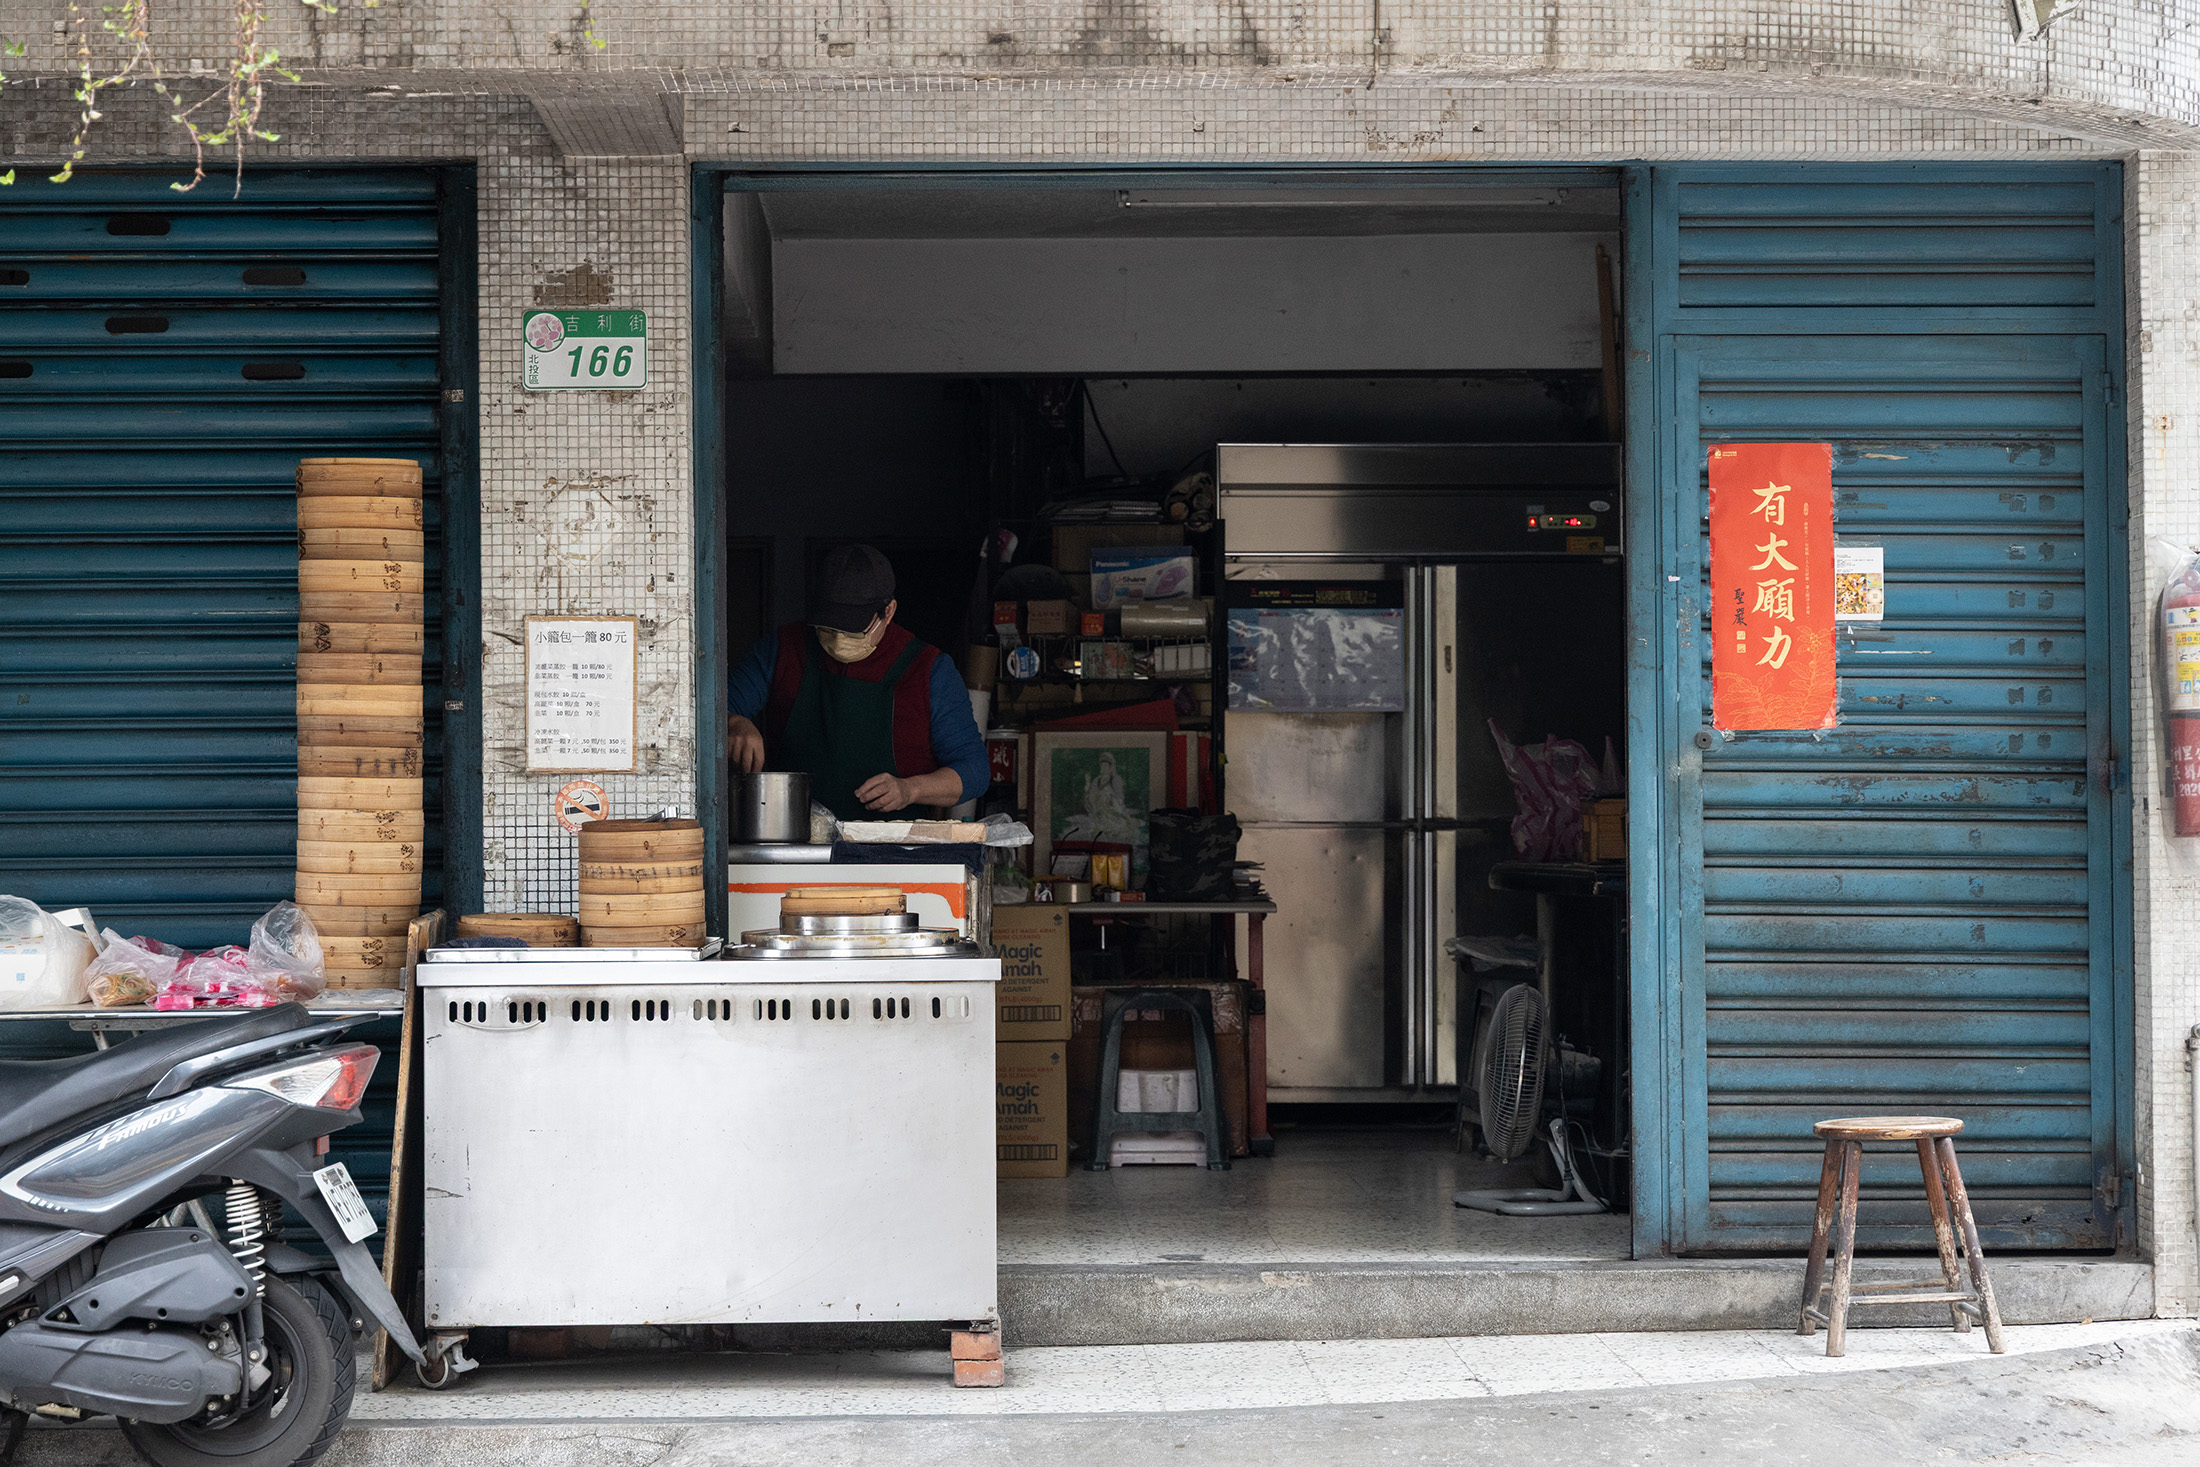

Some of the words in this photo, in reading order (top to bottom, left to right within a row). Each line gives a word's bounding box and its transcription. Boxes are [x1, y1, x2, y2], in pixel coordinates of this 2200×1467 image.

[565, 314, 644, 332] 吉利街
[528, 354, 540, 385] 北投區
[568, 345, 634, 378] 166
[1095, 560, 1130, 568] Panasonic
[1748, 480, 1800, 670] 有大願力
[599, 632, 612, 642] 80
[614, 631, 627, 644] 元
[994, 943, 1043, 963] Magic
[129, 1371, 194, 1392] KYMCO
